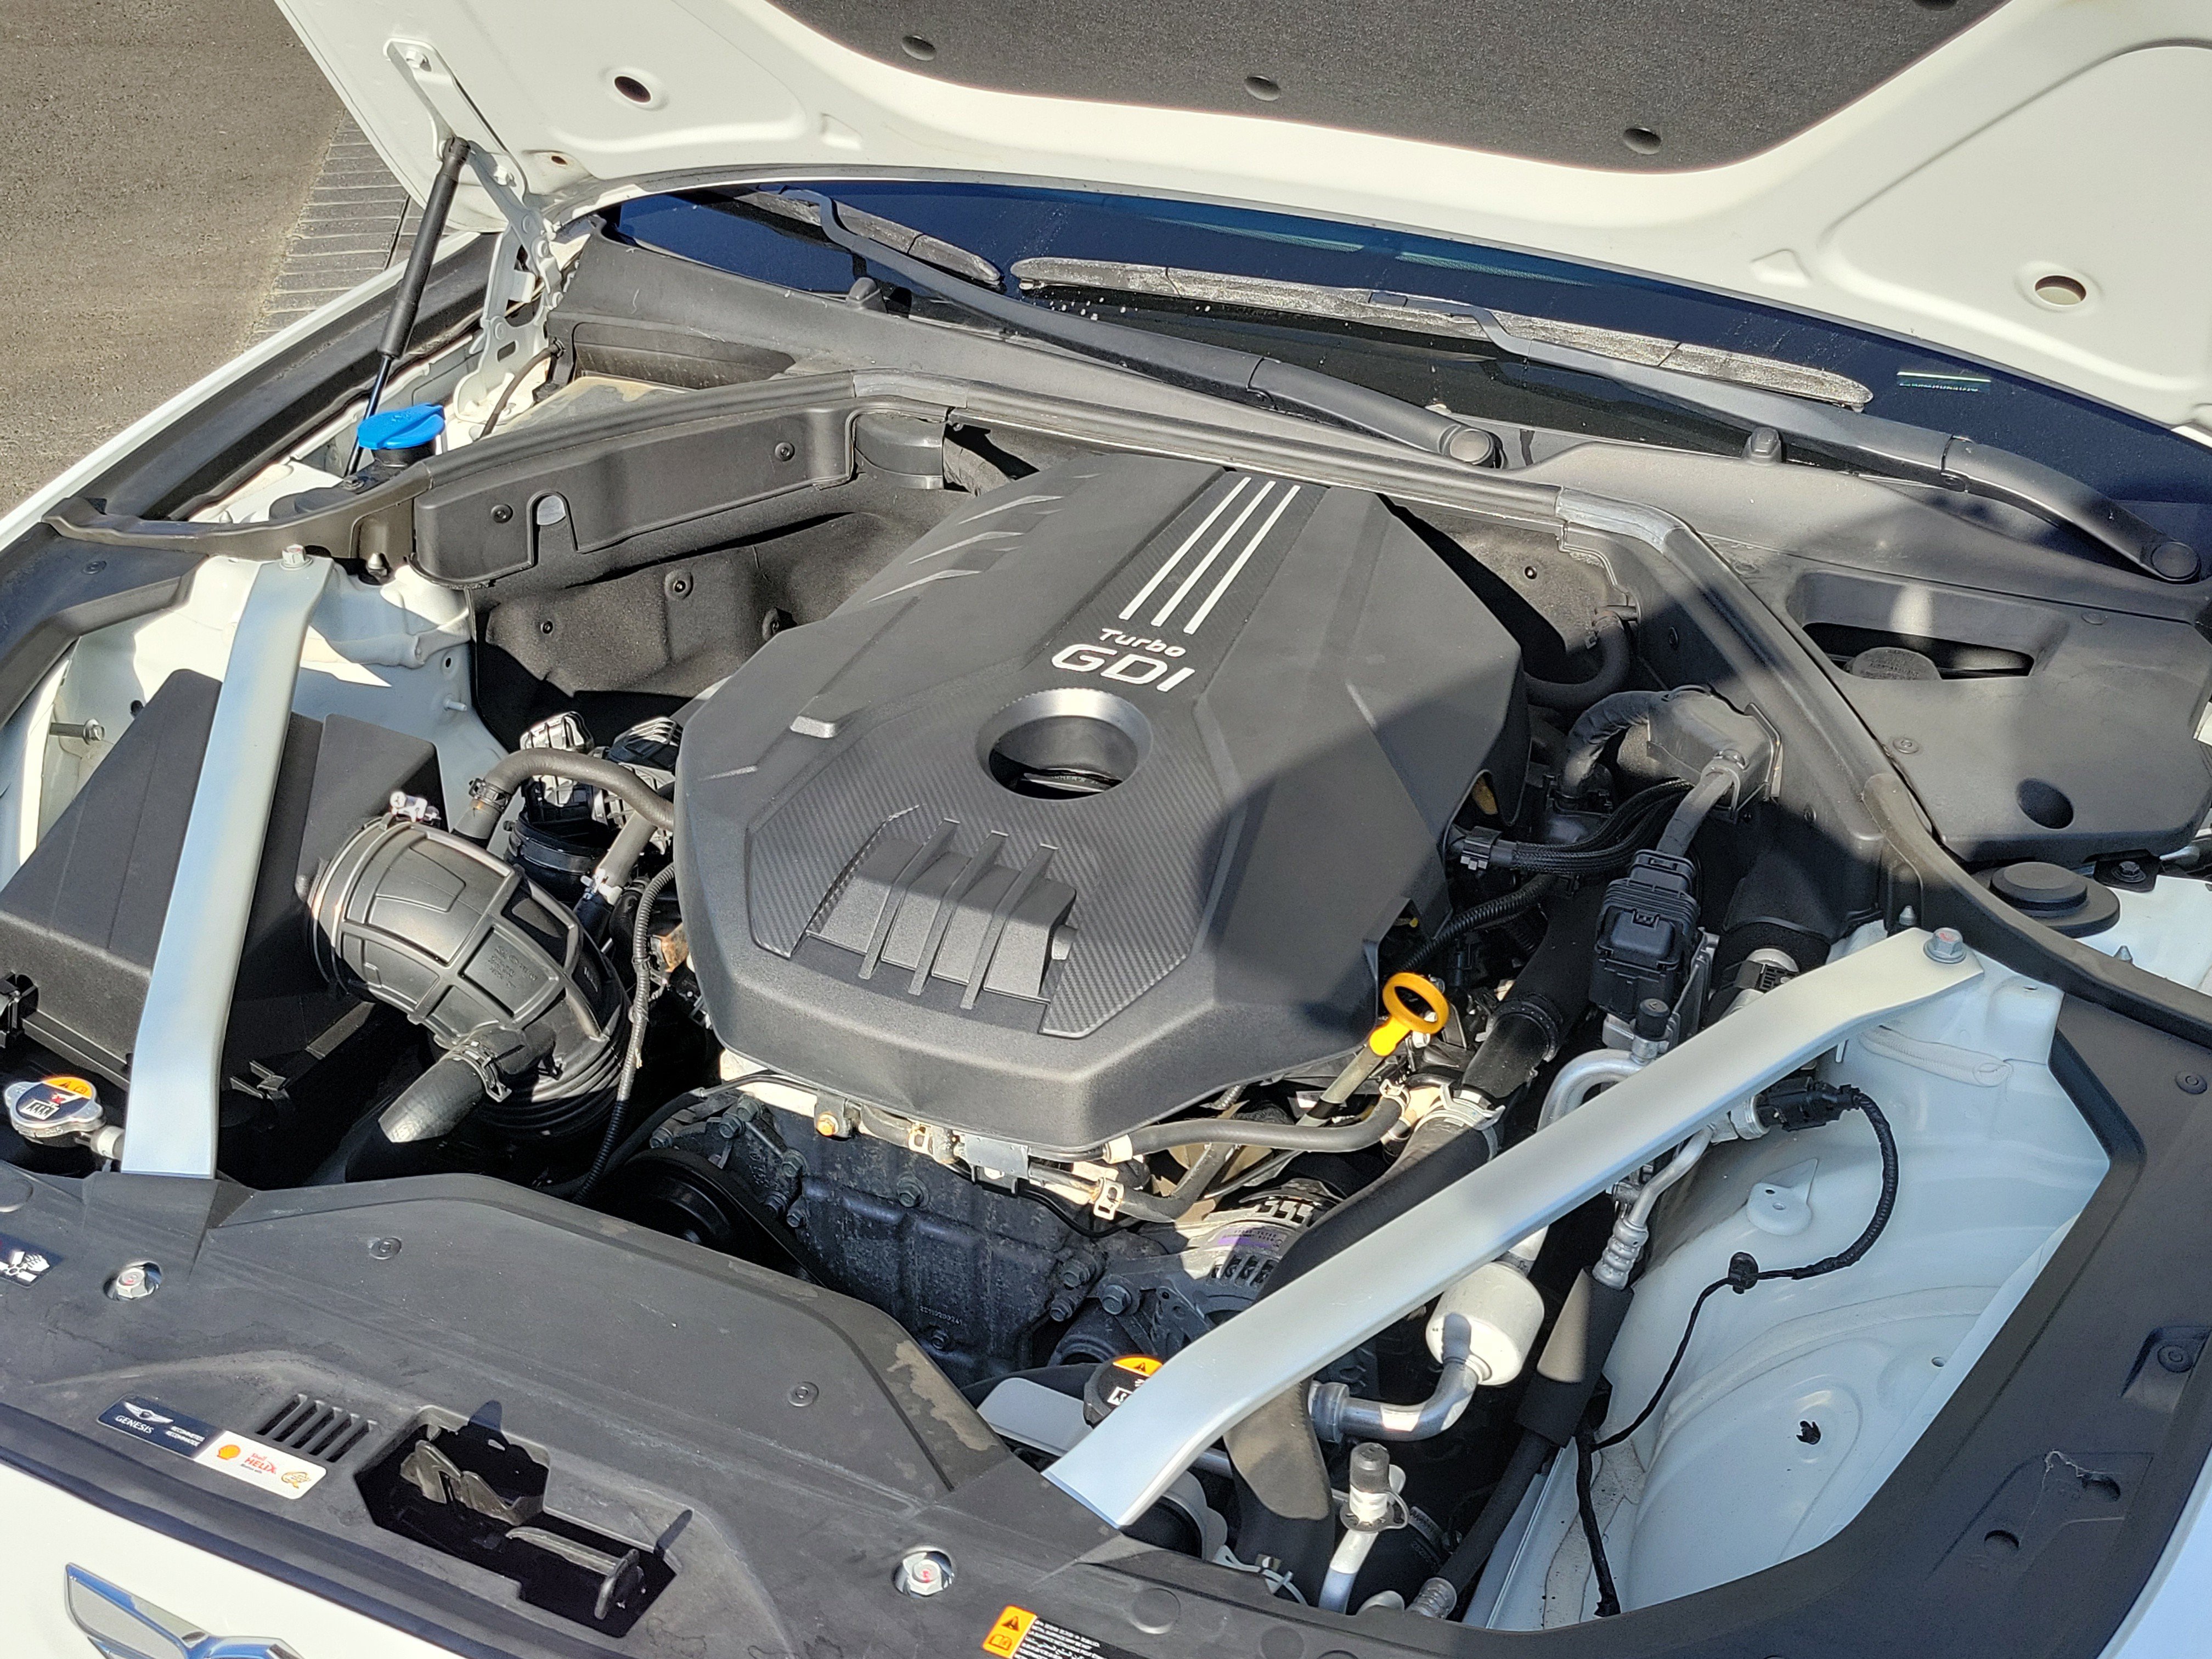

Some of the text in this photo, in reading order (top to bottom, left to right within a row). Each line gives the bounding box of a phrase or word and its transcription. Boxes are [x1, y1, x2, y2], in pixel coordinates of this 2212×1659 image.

[1099, 628, 1186, 658] Turbo
[1051, 644, 1195, 692] GDI
[115, 1415, 155, 1434] GENESIS
[244, 1457, 278, 1474] HELIX
